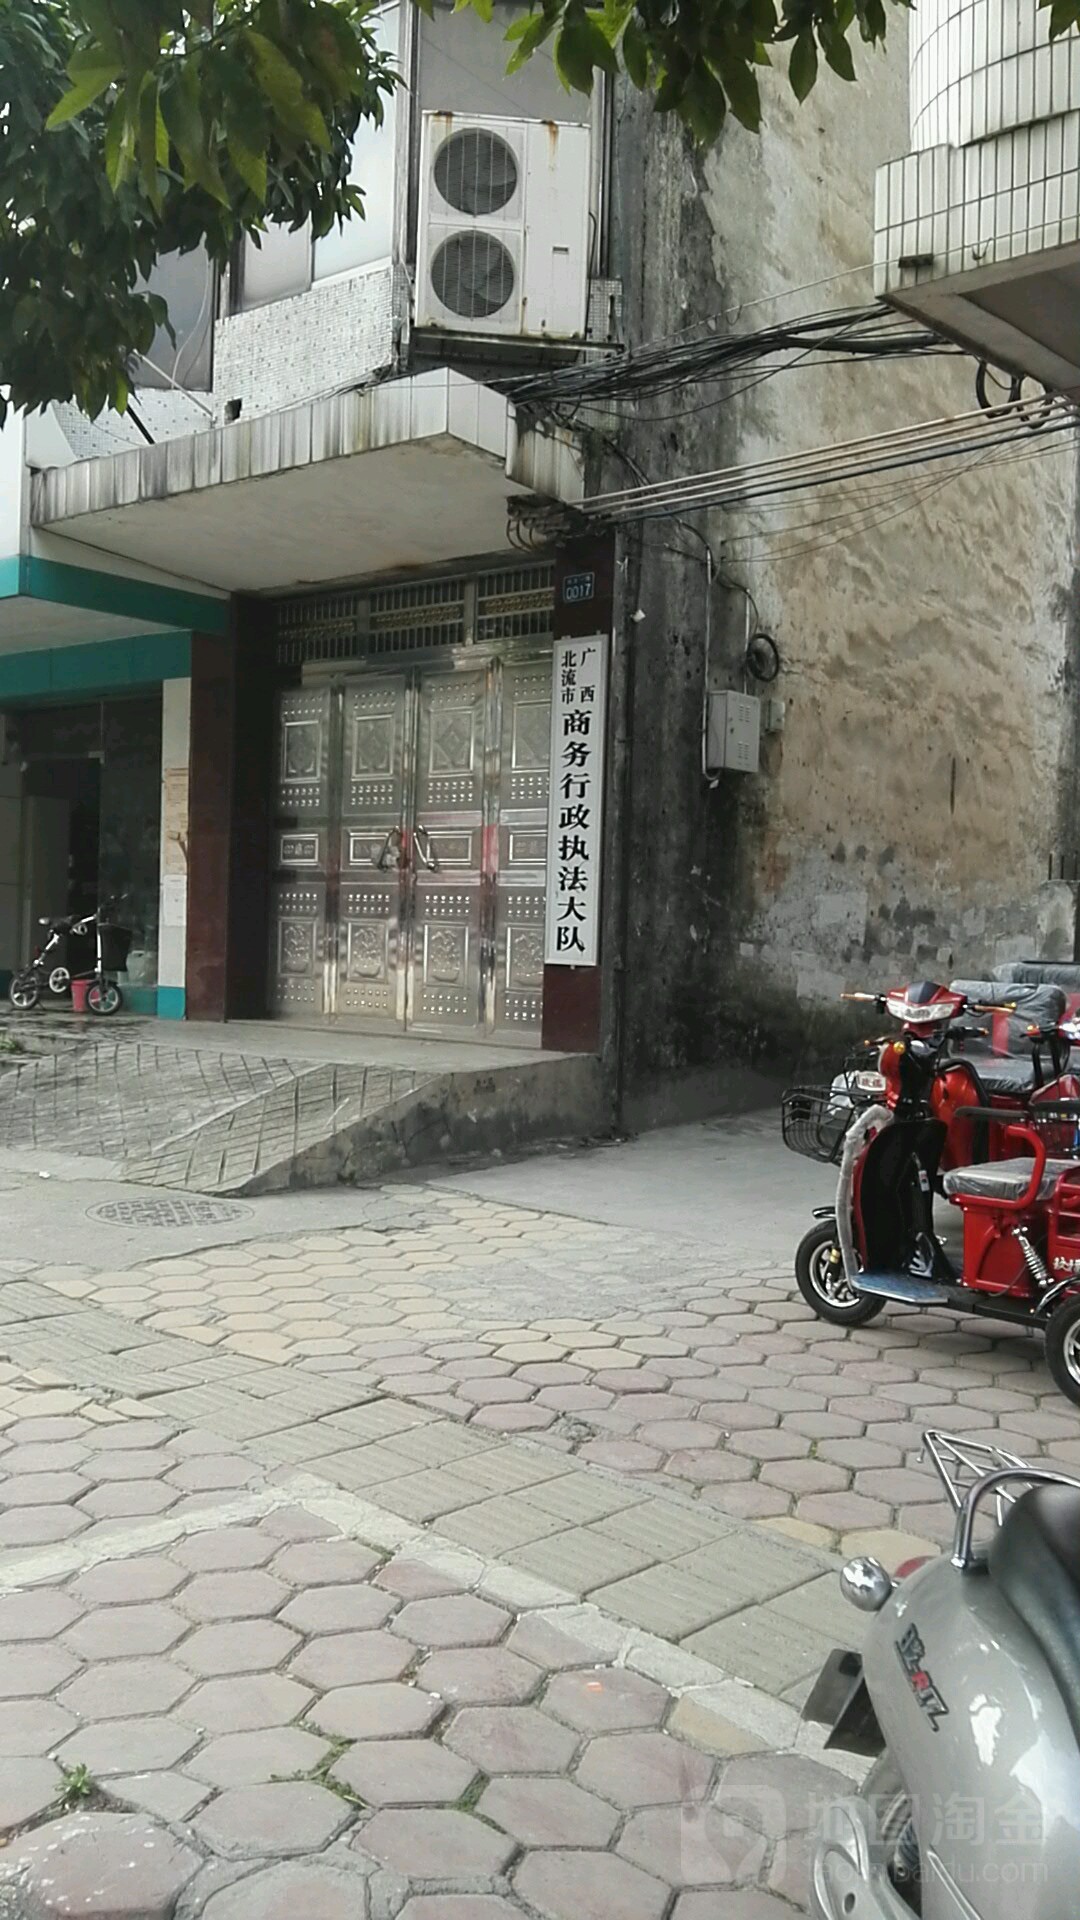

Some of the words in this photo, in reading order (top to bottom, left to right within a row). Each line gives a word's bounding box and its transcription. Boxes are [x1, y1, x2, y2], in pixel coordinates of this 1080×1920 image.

[566, 583, 591, 600] 0017
[561, 650, 577, 705] 北流市
[580, 648, 596, 703] 广西
[556, 709, 592, 952] 商务行政执法大队
